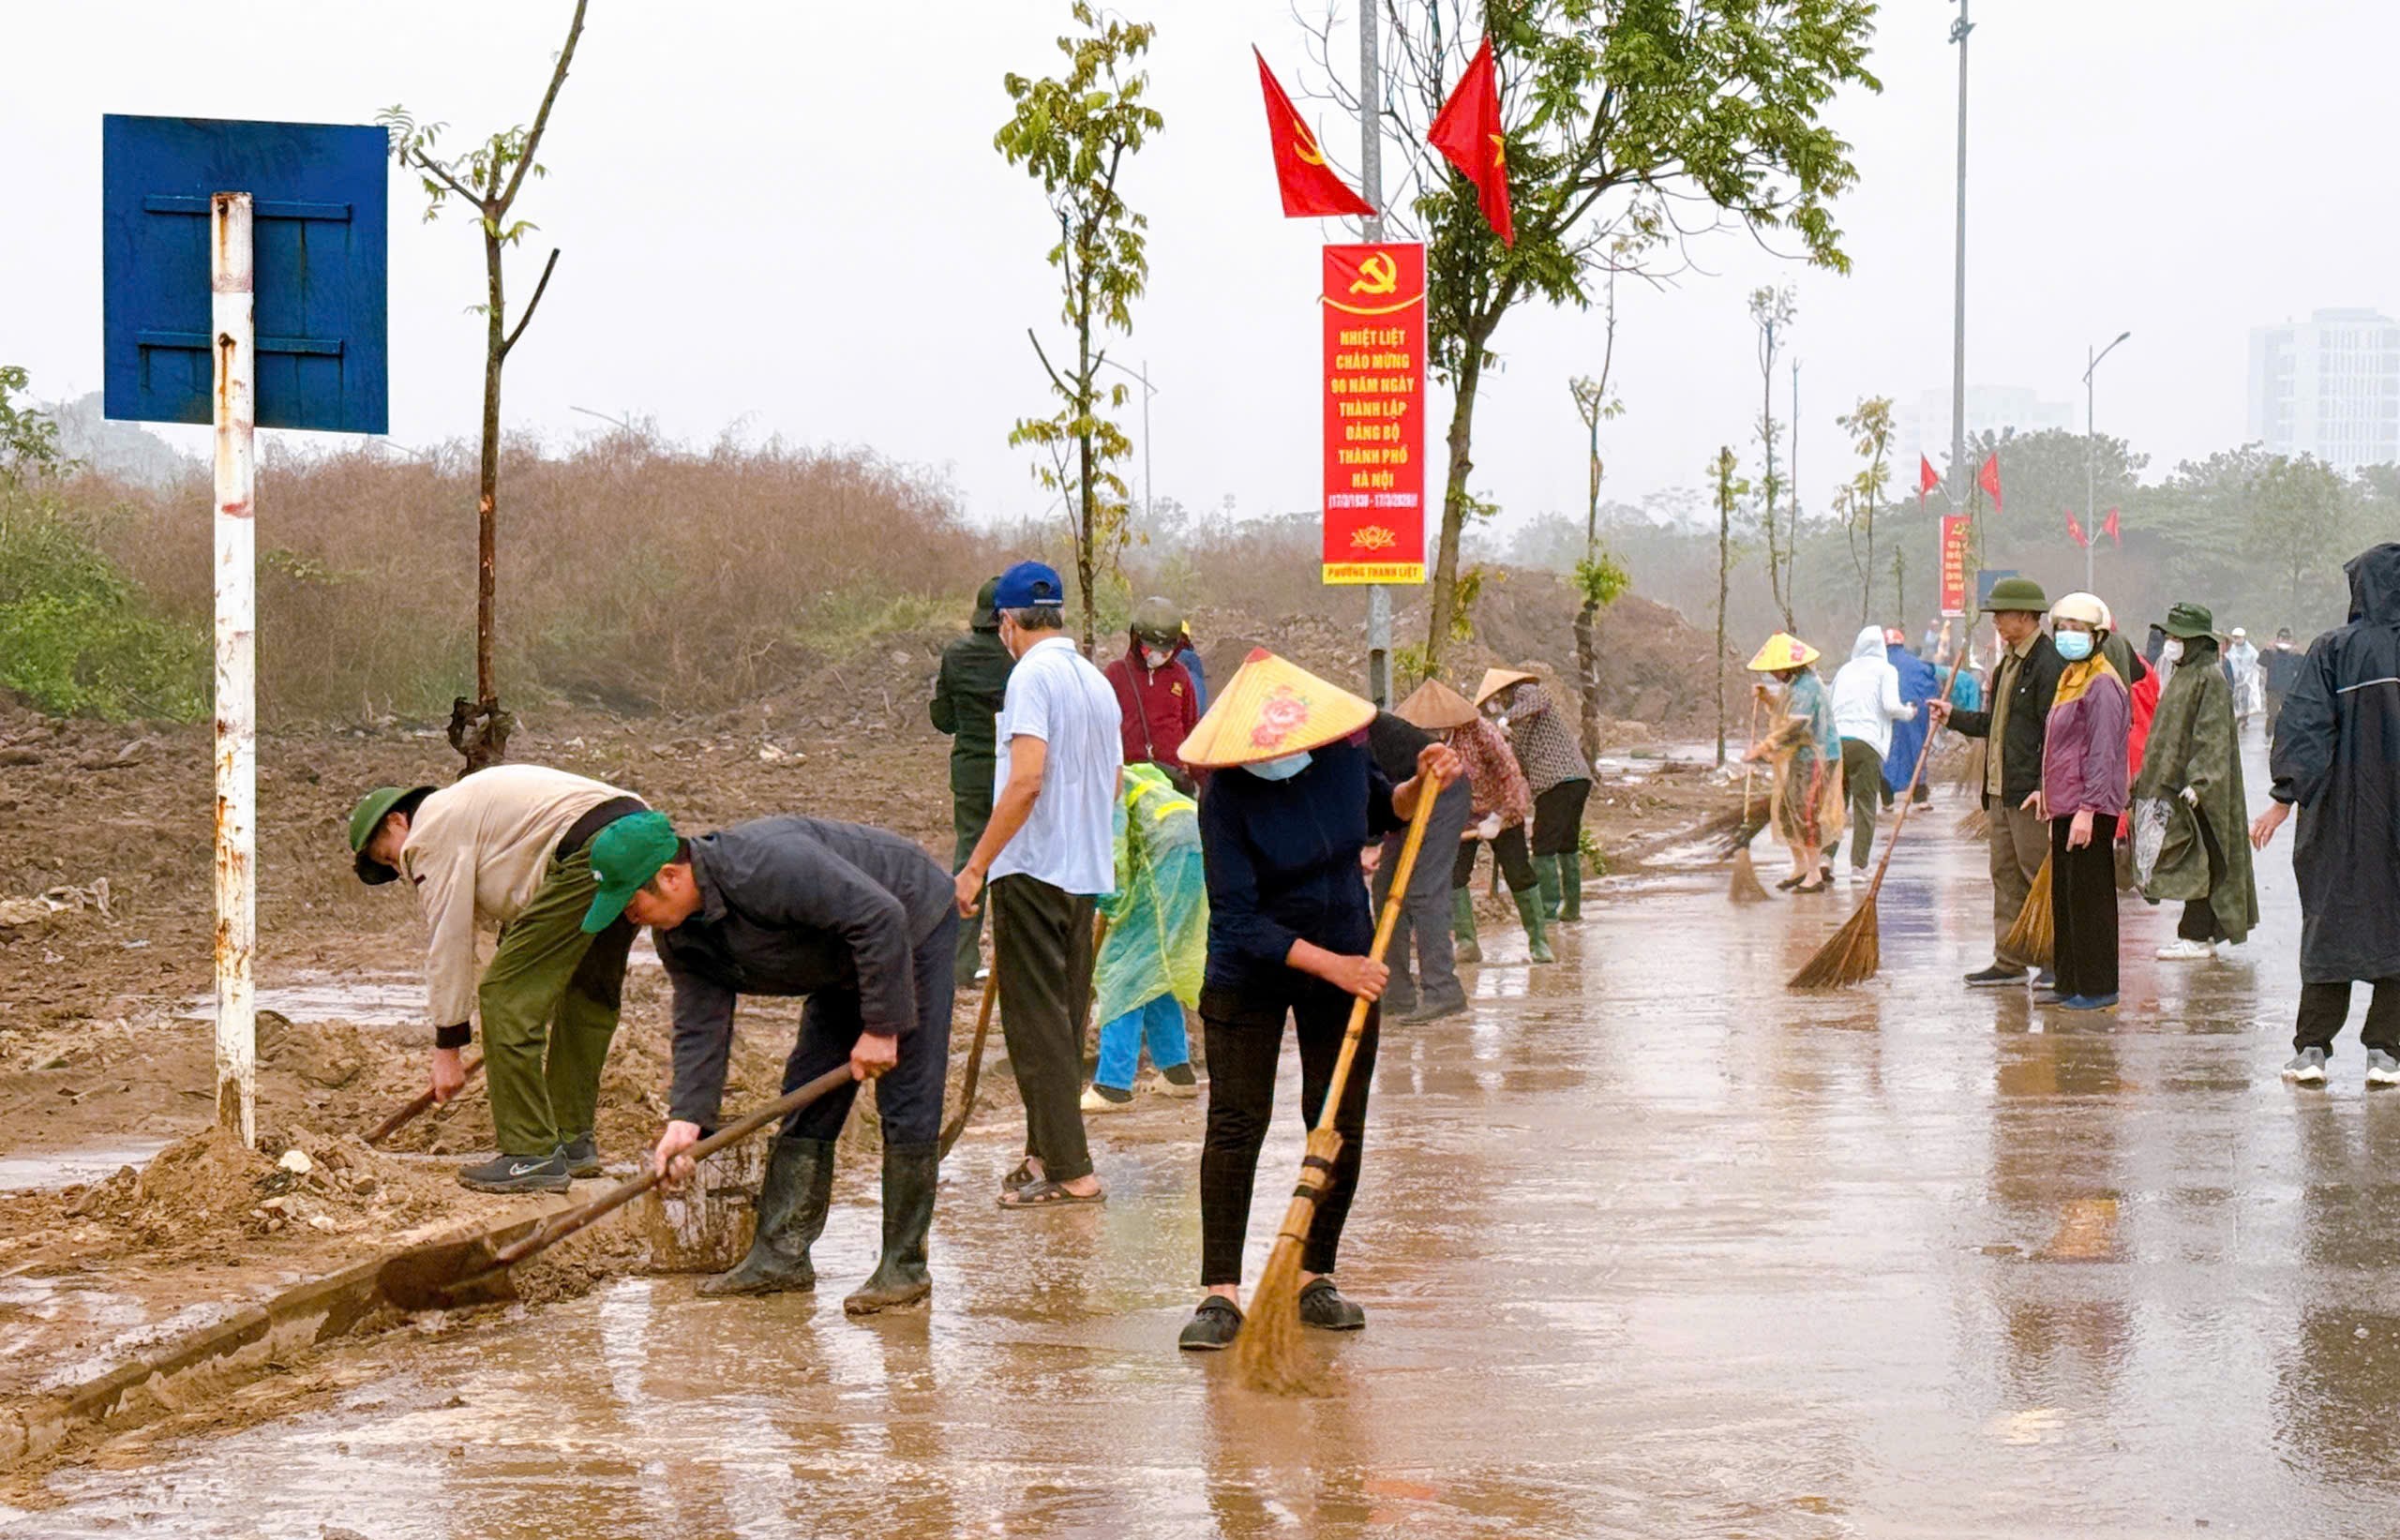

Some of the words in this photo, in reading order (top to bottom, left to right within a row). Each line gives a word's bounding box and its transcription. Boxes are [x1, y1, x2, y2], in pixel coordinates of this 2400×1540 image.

[1379, 327, 1405, 348] LIỆT
[1336, 352, 1369, 369] CHÀO
[1372, 352, 1410, 369] MỪNG
[1381, 375, 1415, 393] NGÀY
[1339, 398, 1380, 417] THÀNH
[1383, 421, 1400, 442] BỘ
[1339, 447, 1380, 464] THÀNH
[1382, 444, 1408, 464] PHỐ
[1352, 470, 1369, 487] HÀ
[1372, 470, 1394, 490] NỘI
